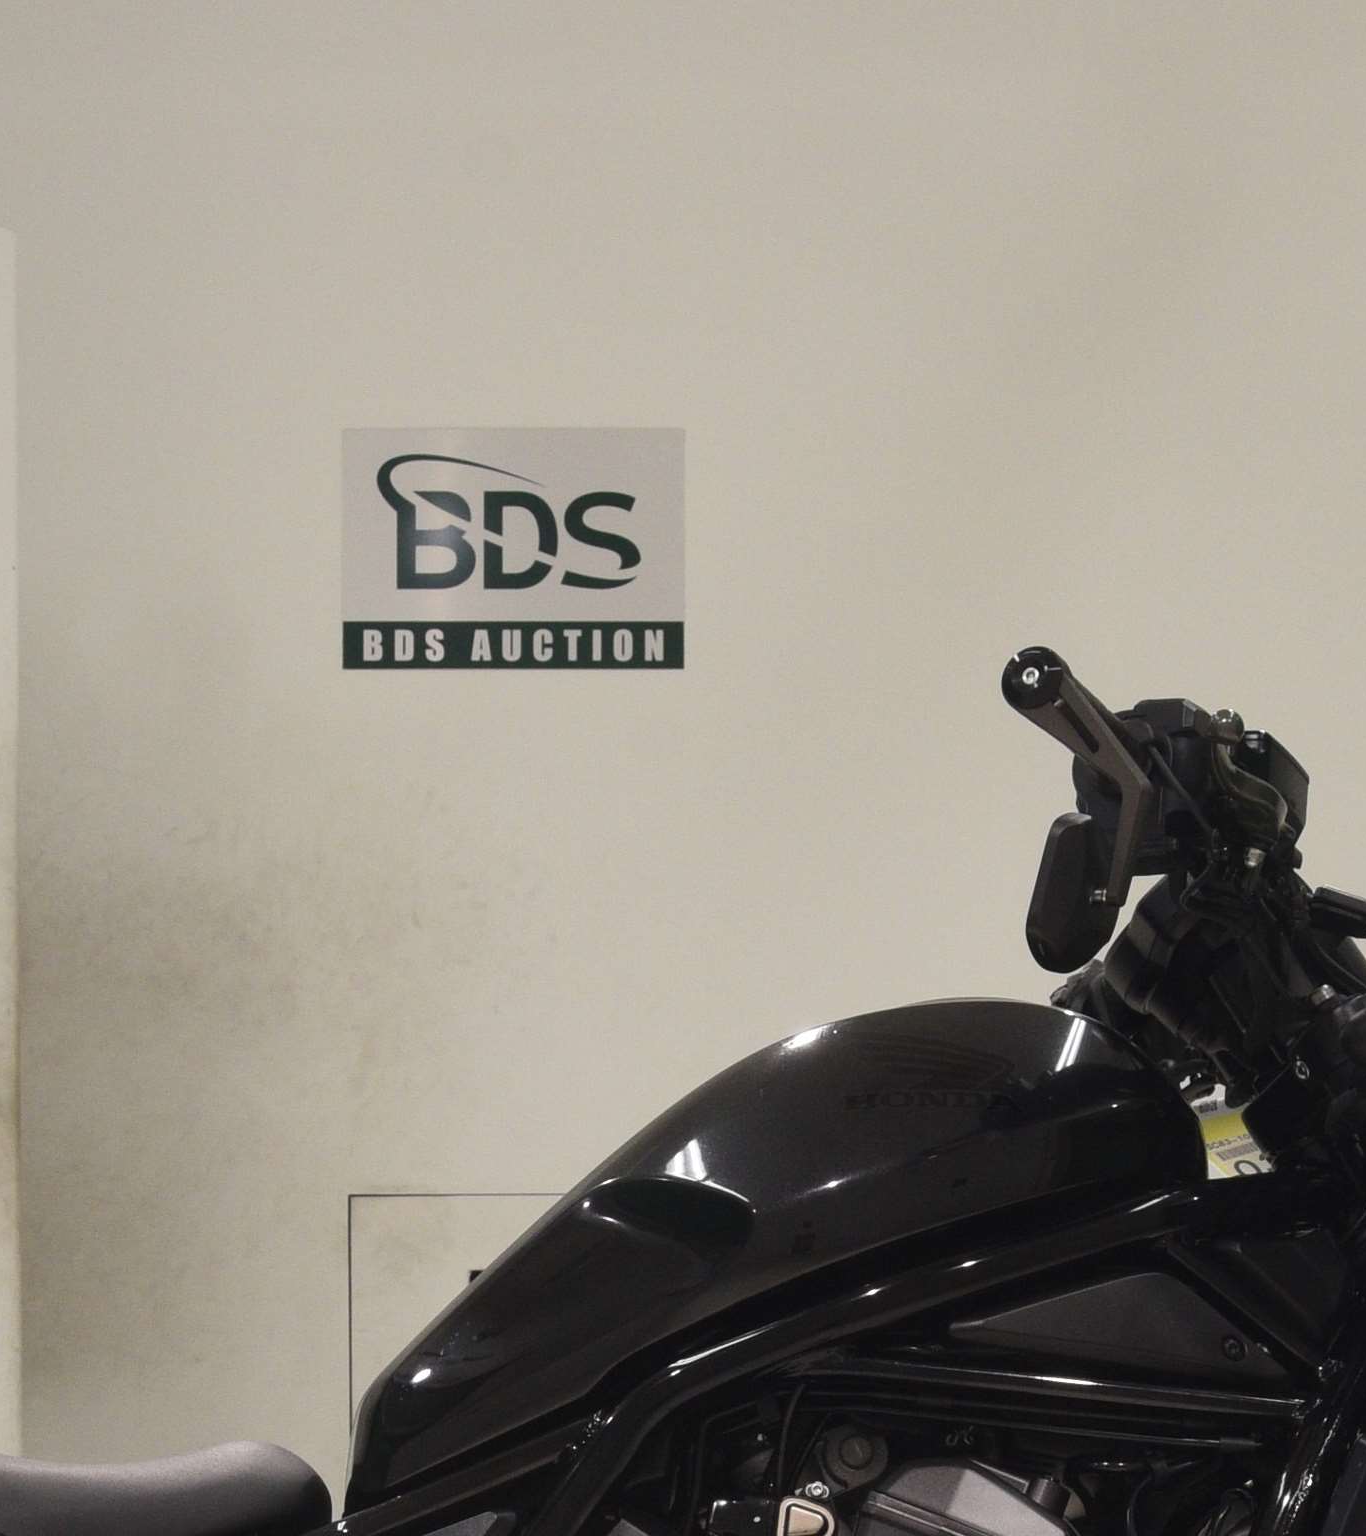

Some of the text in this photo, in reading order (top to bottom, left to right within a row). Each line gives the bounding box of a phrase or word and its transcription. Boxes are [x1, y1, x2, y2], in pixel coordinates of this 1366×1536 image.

[377, 454, 641, 589] BDS
[362, 628, 665, 662] BDS AUCTION
[843, 1092, 1020, 1113] HONDA
